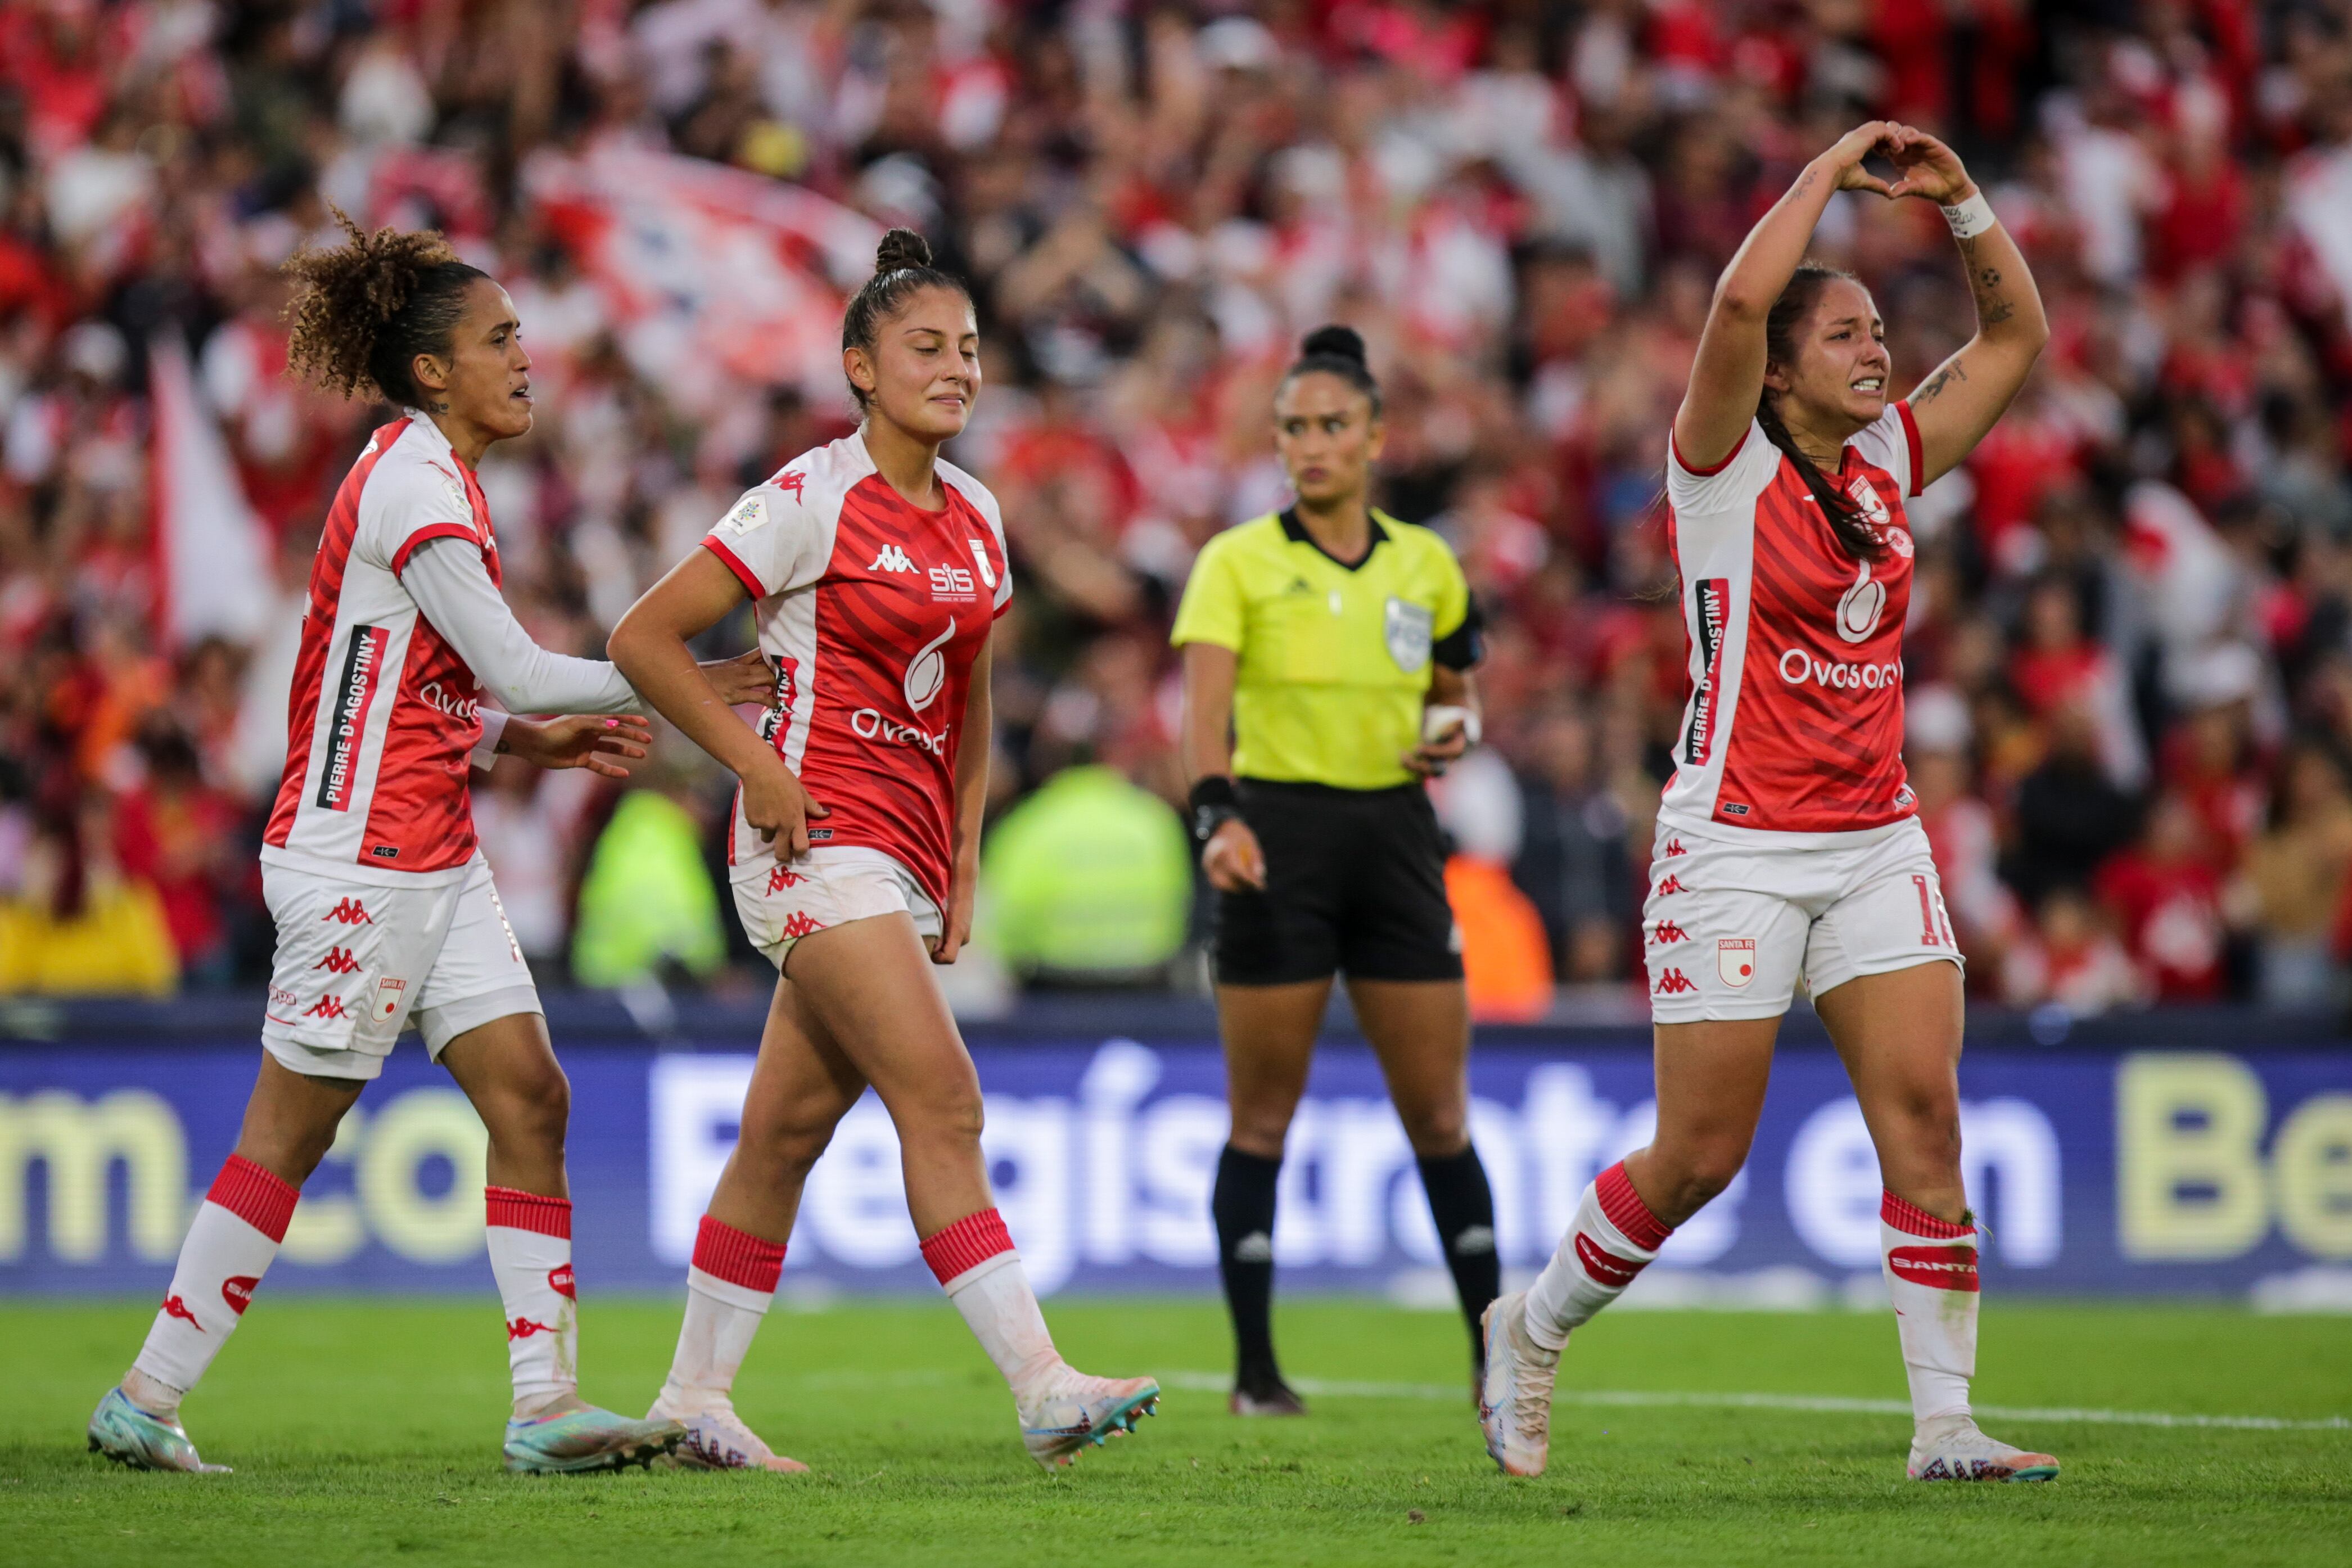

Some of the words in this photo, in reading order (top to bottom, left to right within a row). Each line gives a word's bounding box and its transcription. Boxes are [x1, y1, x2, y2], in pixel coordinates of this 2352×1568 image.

[326, 741, 351, 802] PIERRE
[339, 634, 377, 736] D'AGOSTINY
[1692, 696, 1710, 758] PIERRE
[1719, 940, 1744, 949] SANTA
[1745, 940, 1754, 949] FE
[381, 979, 397, 988] SANTA
[397, 980, 405, 989] FE
[1784, 1095, 2062, 1268] en
[1891, 1257, 1977, 1273] SANTA
